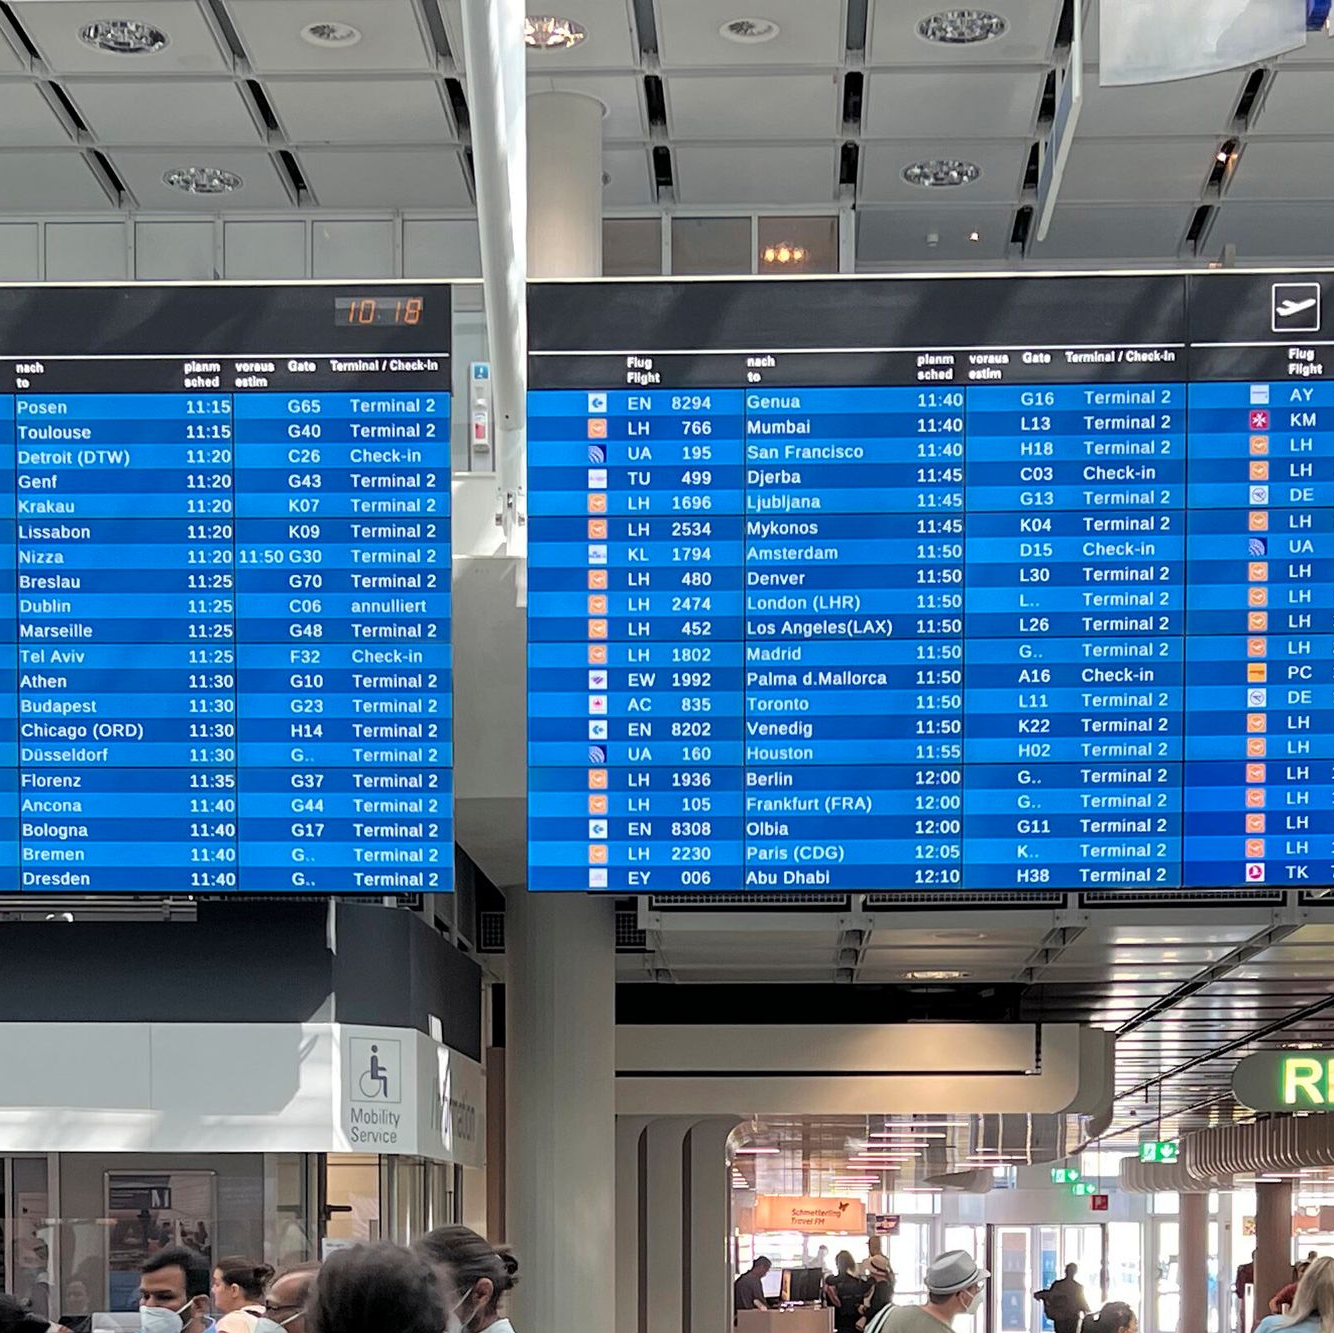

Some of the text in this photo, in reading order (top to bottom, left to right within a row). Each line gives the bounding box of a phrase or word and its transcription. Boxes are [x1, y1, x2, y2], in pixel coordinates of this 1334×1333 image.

[1290, 412, 1317, 427] KM
[17, 450, 73, 465] Detroit
[77, 449, 130, 468] (DTW)
[186, 449, 233, 464] 11:20
[288, 448, 321, 464] C26
[349, 448, 422, 463] Check-in
[627, 439, 1171, 461] UA 195 San Francisco 11:40 H18 Terminal 2
[19, 599, 71, 613] Dublin
[188, 599, 234, 614] 11:25
[289, 599, 322, 613] C06
[351, 598, 427, 613] annulliert
[1287, 715, 1310, 730] LH
[628, 867, 1167, 885] EY 006 Abu Dhabi 12:10 H38 Terminal 2
[350, 1107, 400, 1128] Mobility
[350, 1126, 398, 1144] Service
